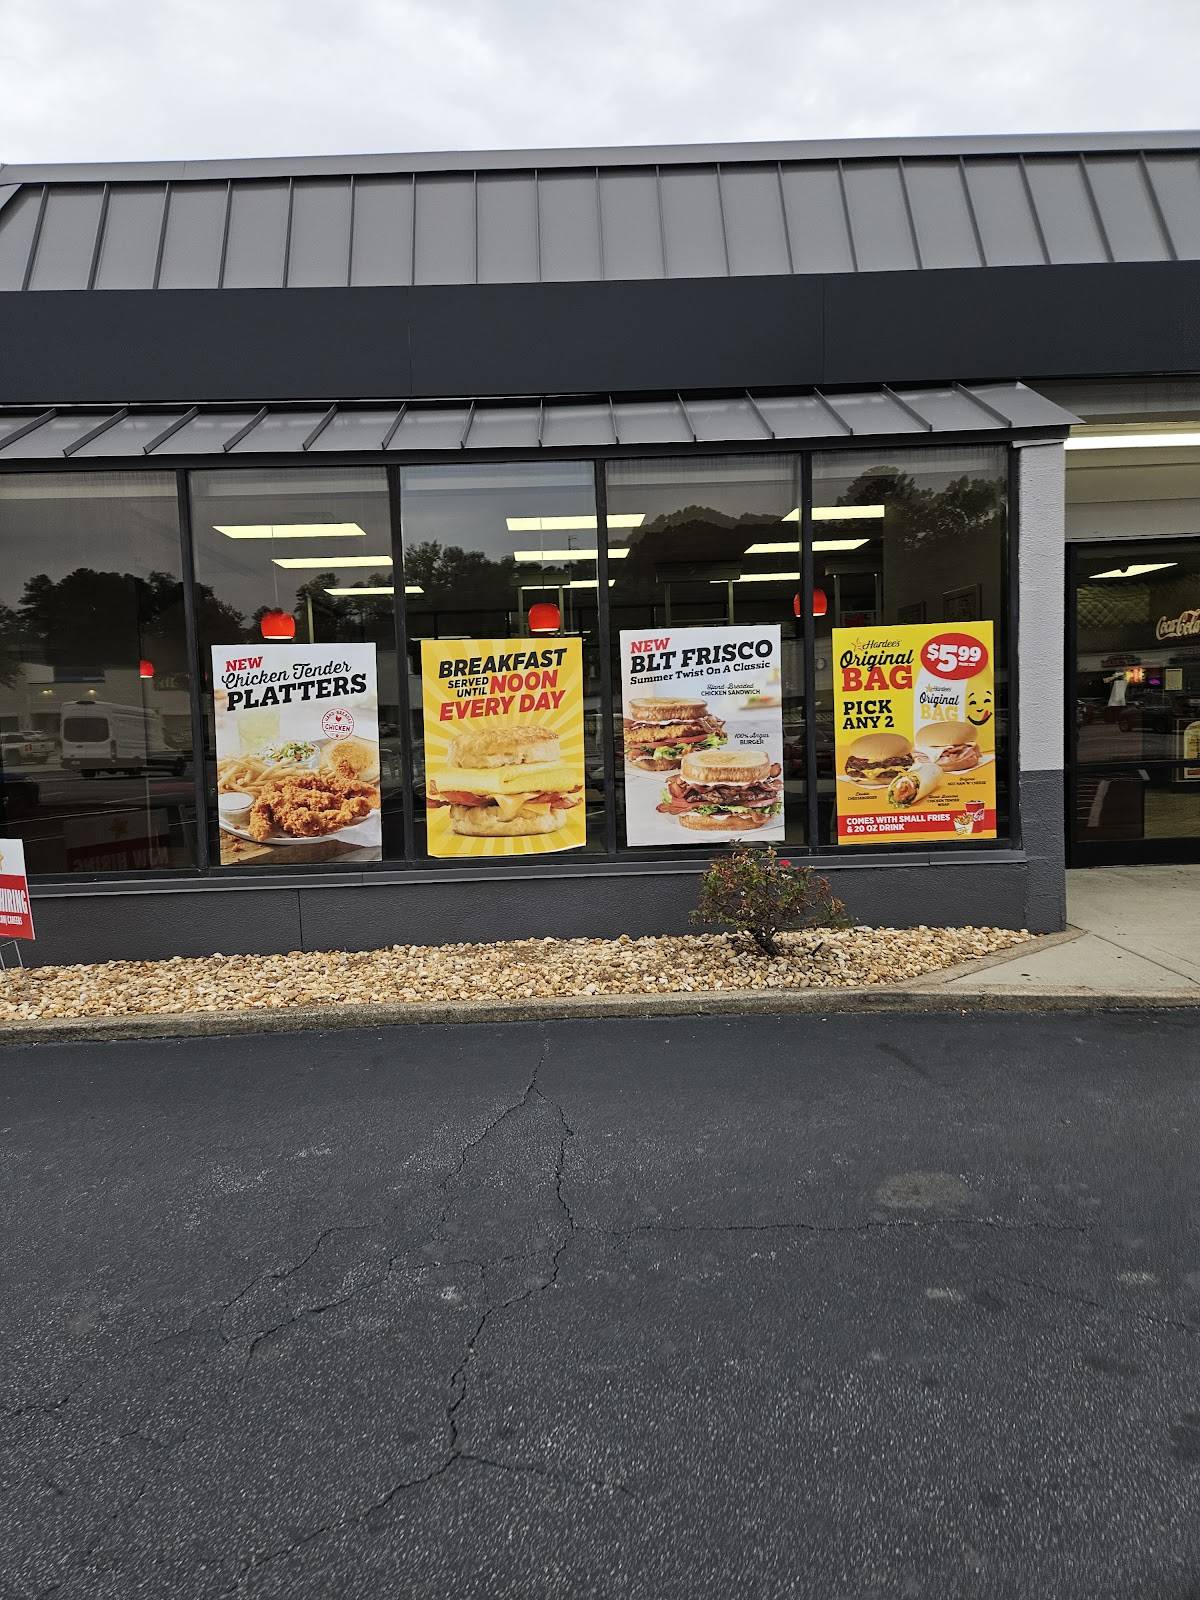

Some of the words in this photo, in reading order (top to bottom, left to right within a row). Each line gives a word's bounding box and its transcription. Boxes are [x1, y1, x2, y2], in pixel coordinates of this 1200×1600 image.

[630, 637, 671, 654] NEW
[225, 656, 263, 672] NEW
[438, 648, 568, 679] BREAKFAST
[630, 650, 677, 674] BLT
[680, 639, 773, 668] FRISCO
[840, 649, 914, 672] Original
[221, 669, 289, 690] Chicken
[292, 660, 352, 680] Tender
[630, 673, 674, 685] Summer
[675, 668, 704, 680] Twist
[706, 666, 721, 676] On
[722, 665, 731, 674] A
[733, 660, 771, 672] Classic
[842, 665, 913, 692] BAG
[447, 676, 489, 689] SERVED
[489, 669, 559, 695] NOON
[226, 673, 367, 712] PLATTERS
[456, 687, 488, 698] UNTIL
[919, 691, 960, 708] Original
[439, 695, 516, 722] EVERY
[518, 690, 567, 713] DAY
[843, 699, 893, 716] PICK
[921, 704, 959, 721] BAG
[325, 723, 351, 732] CHICKEN
[842, 716, 879, 730] ANY
[884, 715, 895, 728] 2
[846, 817, 875, 826] COMES
[876, 816, 898, 824] WITH
[898, 814, 926, 823] SMALL
[927, 813, 951, 822] FRIES
[854, 825, 865, 833] 20
[866, 824, 878, 832] OZ
[879, 823, 905, 832] DRINK
[0, 888, 29, 915] HIRING
